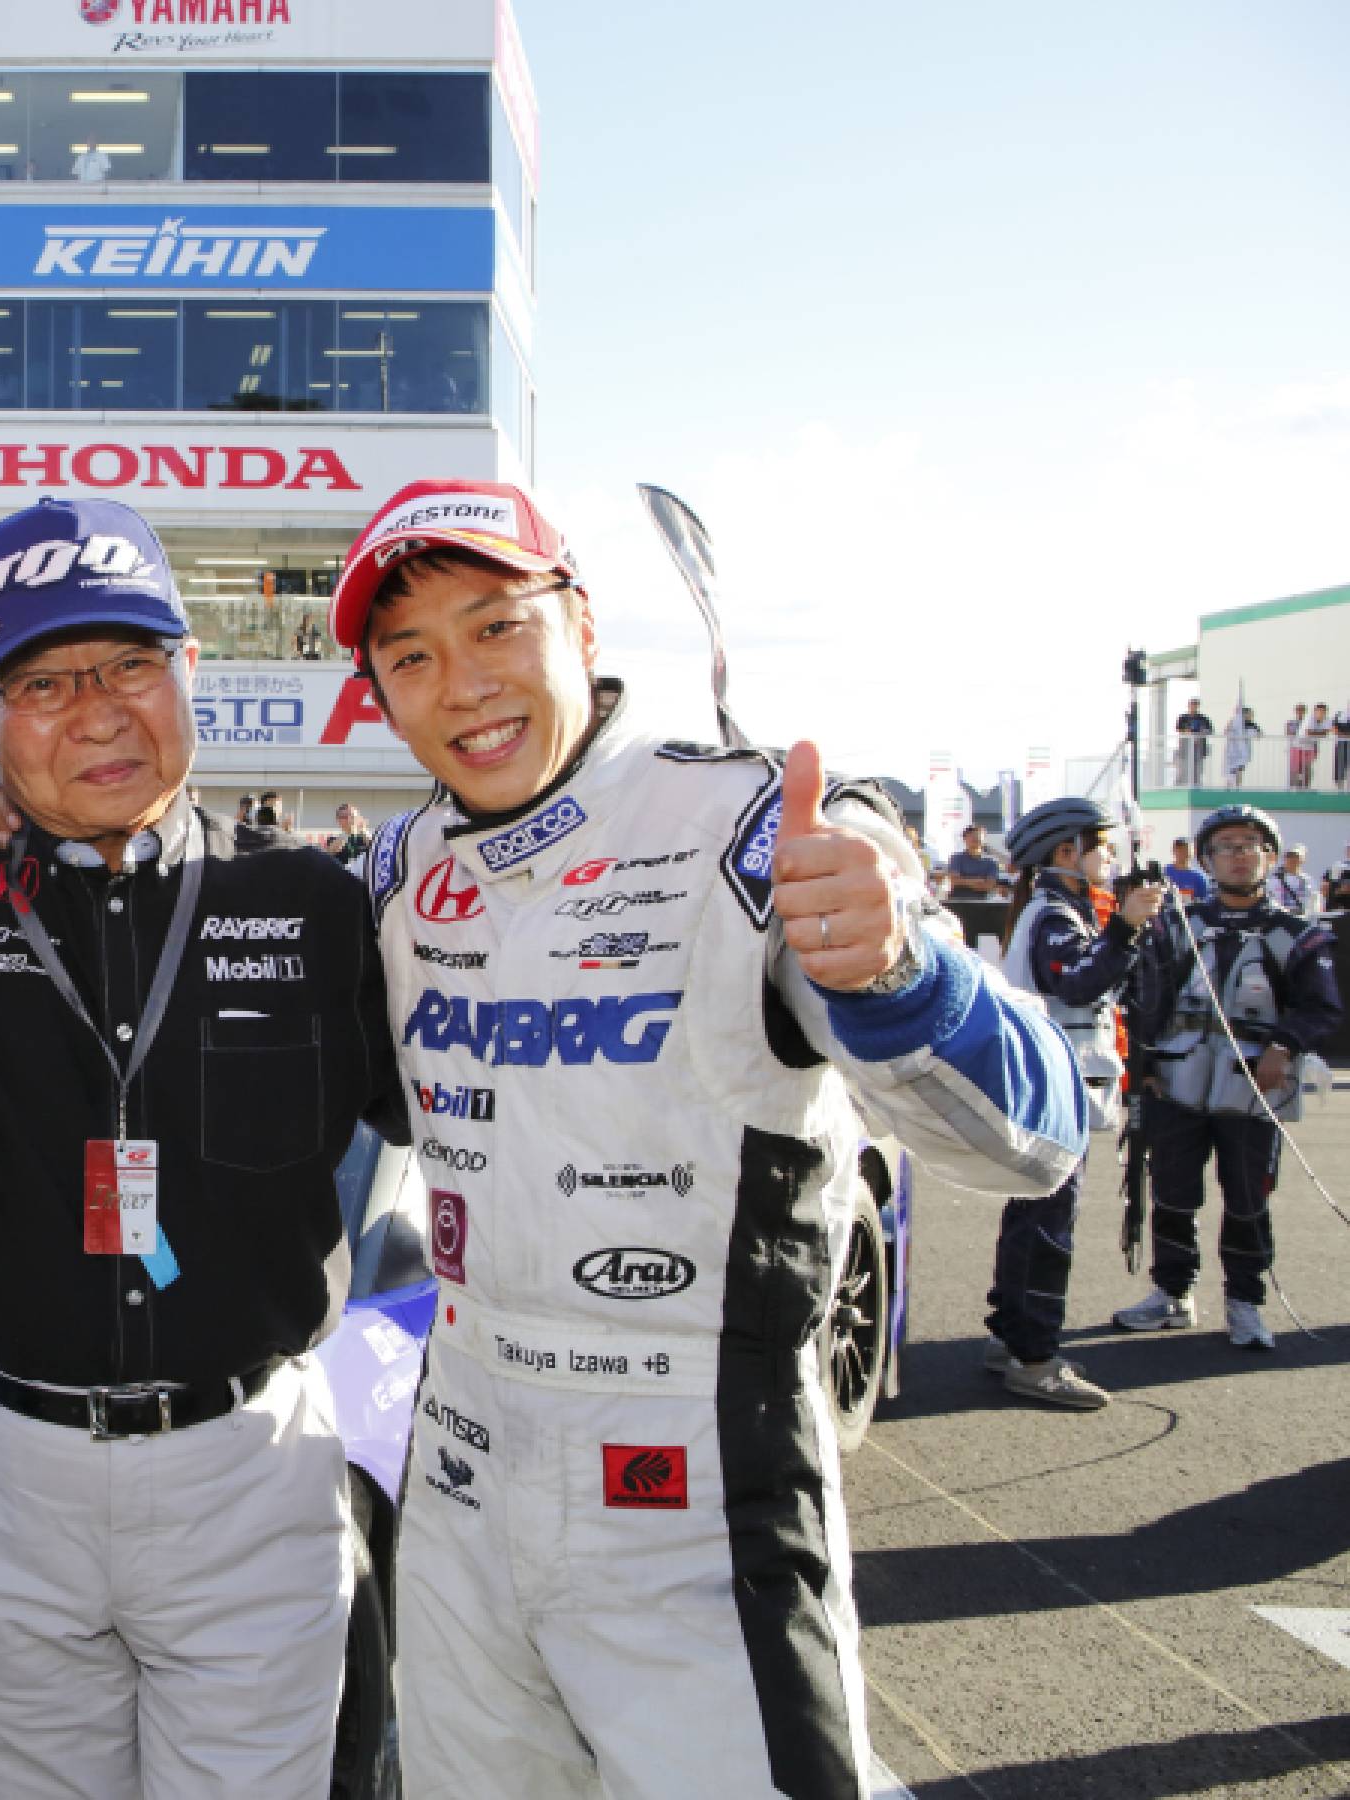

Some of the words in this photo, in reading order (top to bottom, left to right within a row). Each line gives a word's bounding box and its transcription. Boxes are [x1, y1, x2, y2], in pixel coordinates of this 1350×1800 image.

[131, 0, 291, 25] YAMAHA
[34, 216, 327, 277] KEIHIN
[193, 699, 303, 727] STO
[197, 729, 274, 743] ATION
[482, 803, 580, 871] sparco
[200, 916, 306, 940] RAYBRIG
[206, 956, 276, 981] Mobil
[579, 1171, 669, 1188] SILENCIA
[581, 1251, 681, 1284] Arai
[494, 1334, 556, 1371] Takuya
[569, 1349, 629, 1376] Izawa
